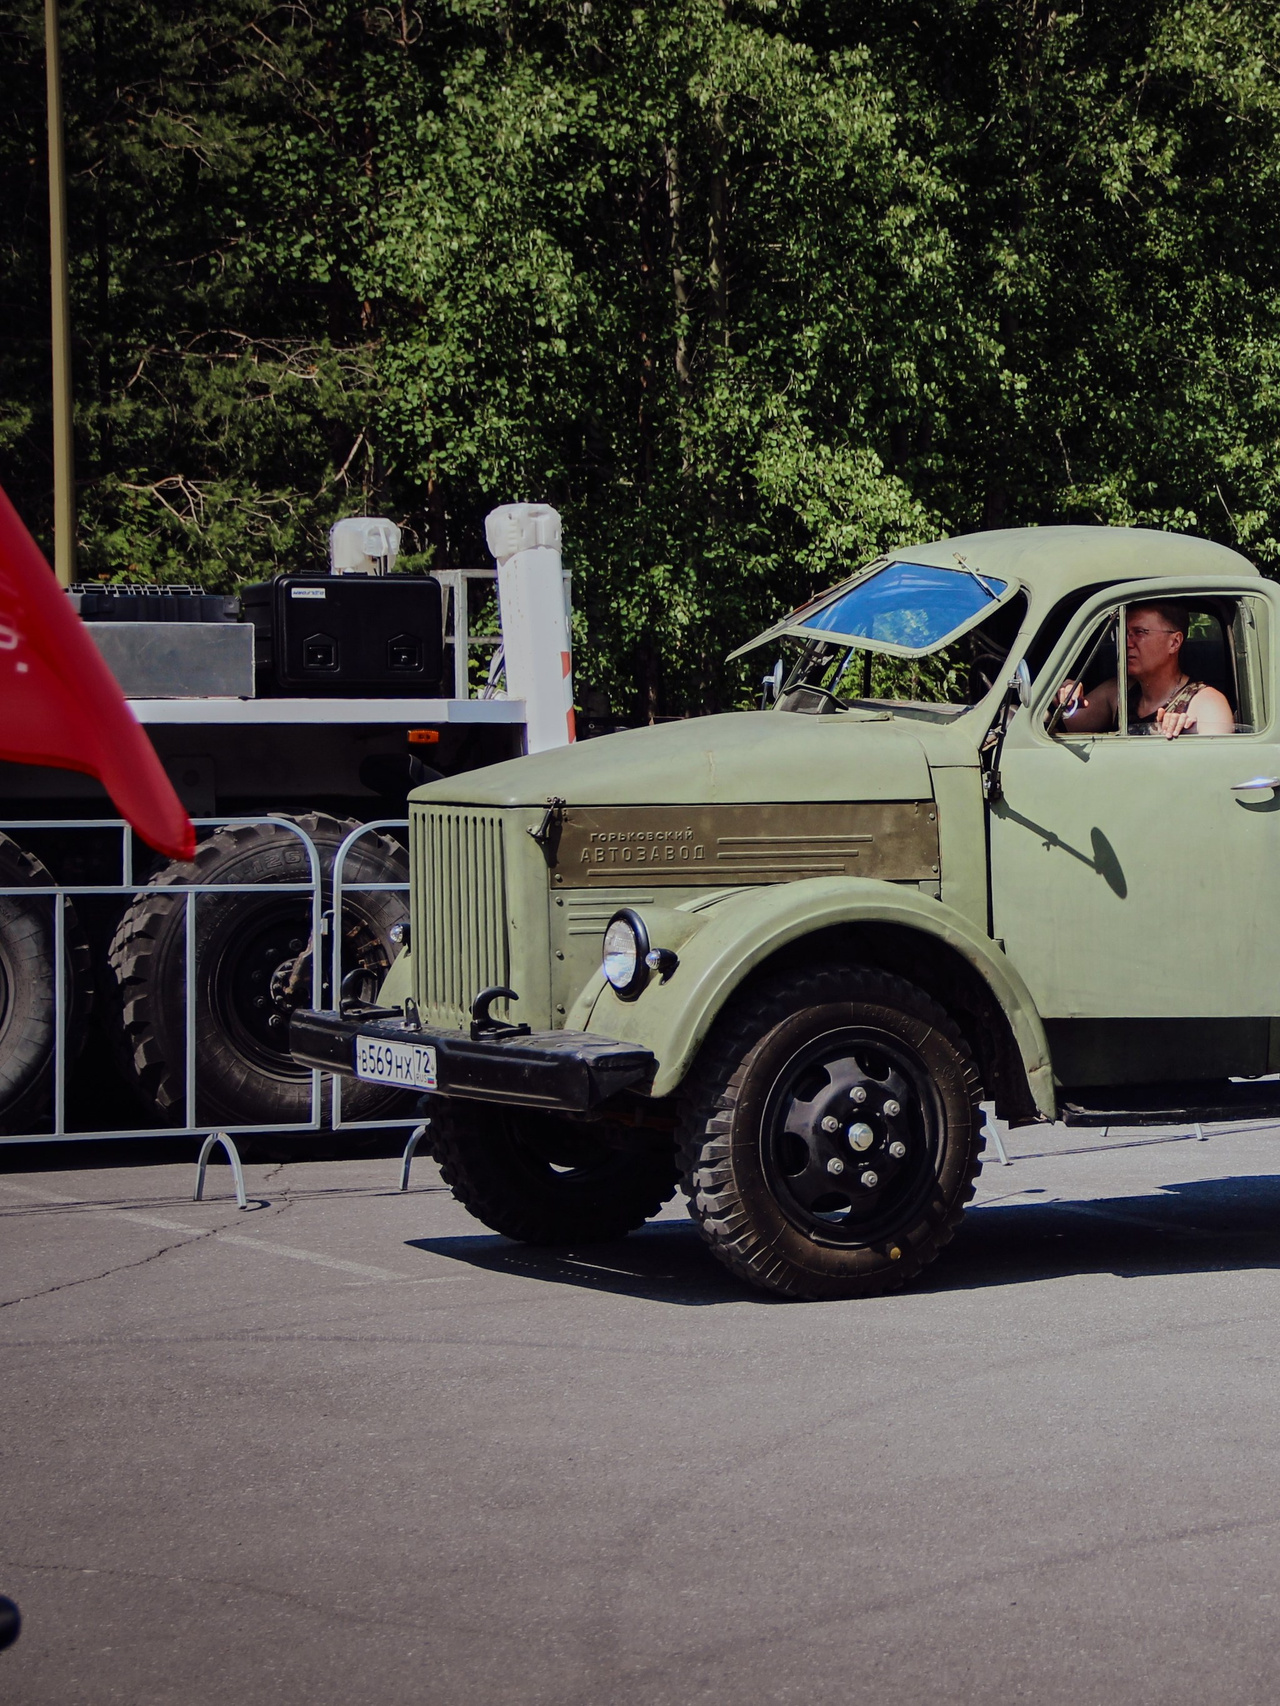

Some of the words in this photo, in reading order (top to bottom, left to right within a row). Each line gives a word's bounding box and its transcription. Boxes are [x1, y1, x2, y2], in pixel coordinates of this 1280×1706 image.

[590, 826, 694, 842] ГОРЬКОВСКИЙ
[580, 844, 706, 863] АВТОЗАВОД
[415, 1050, 431, 1073] 72
